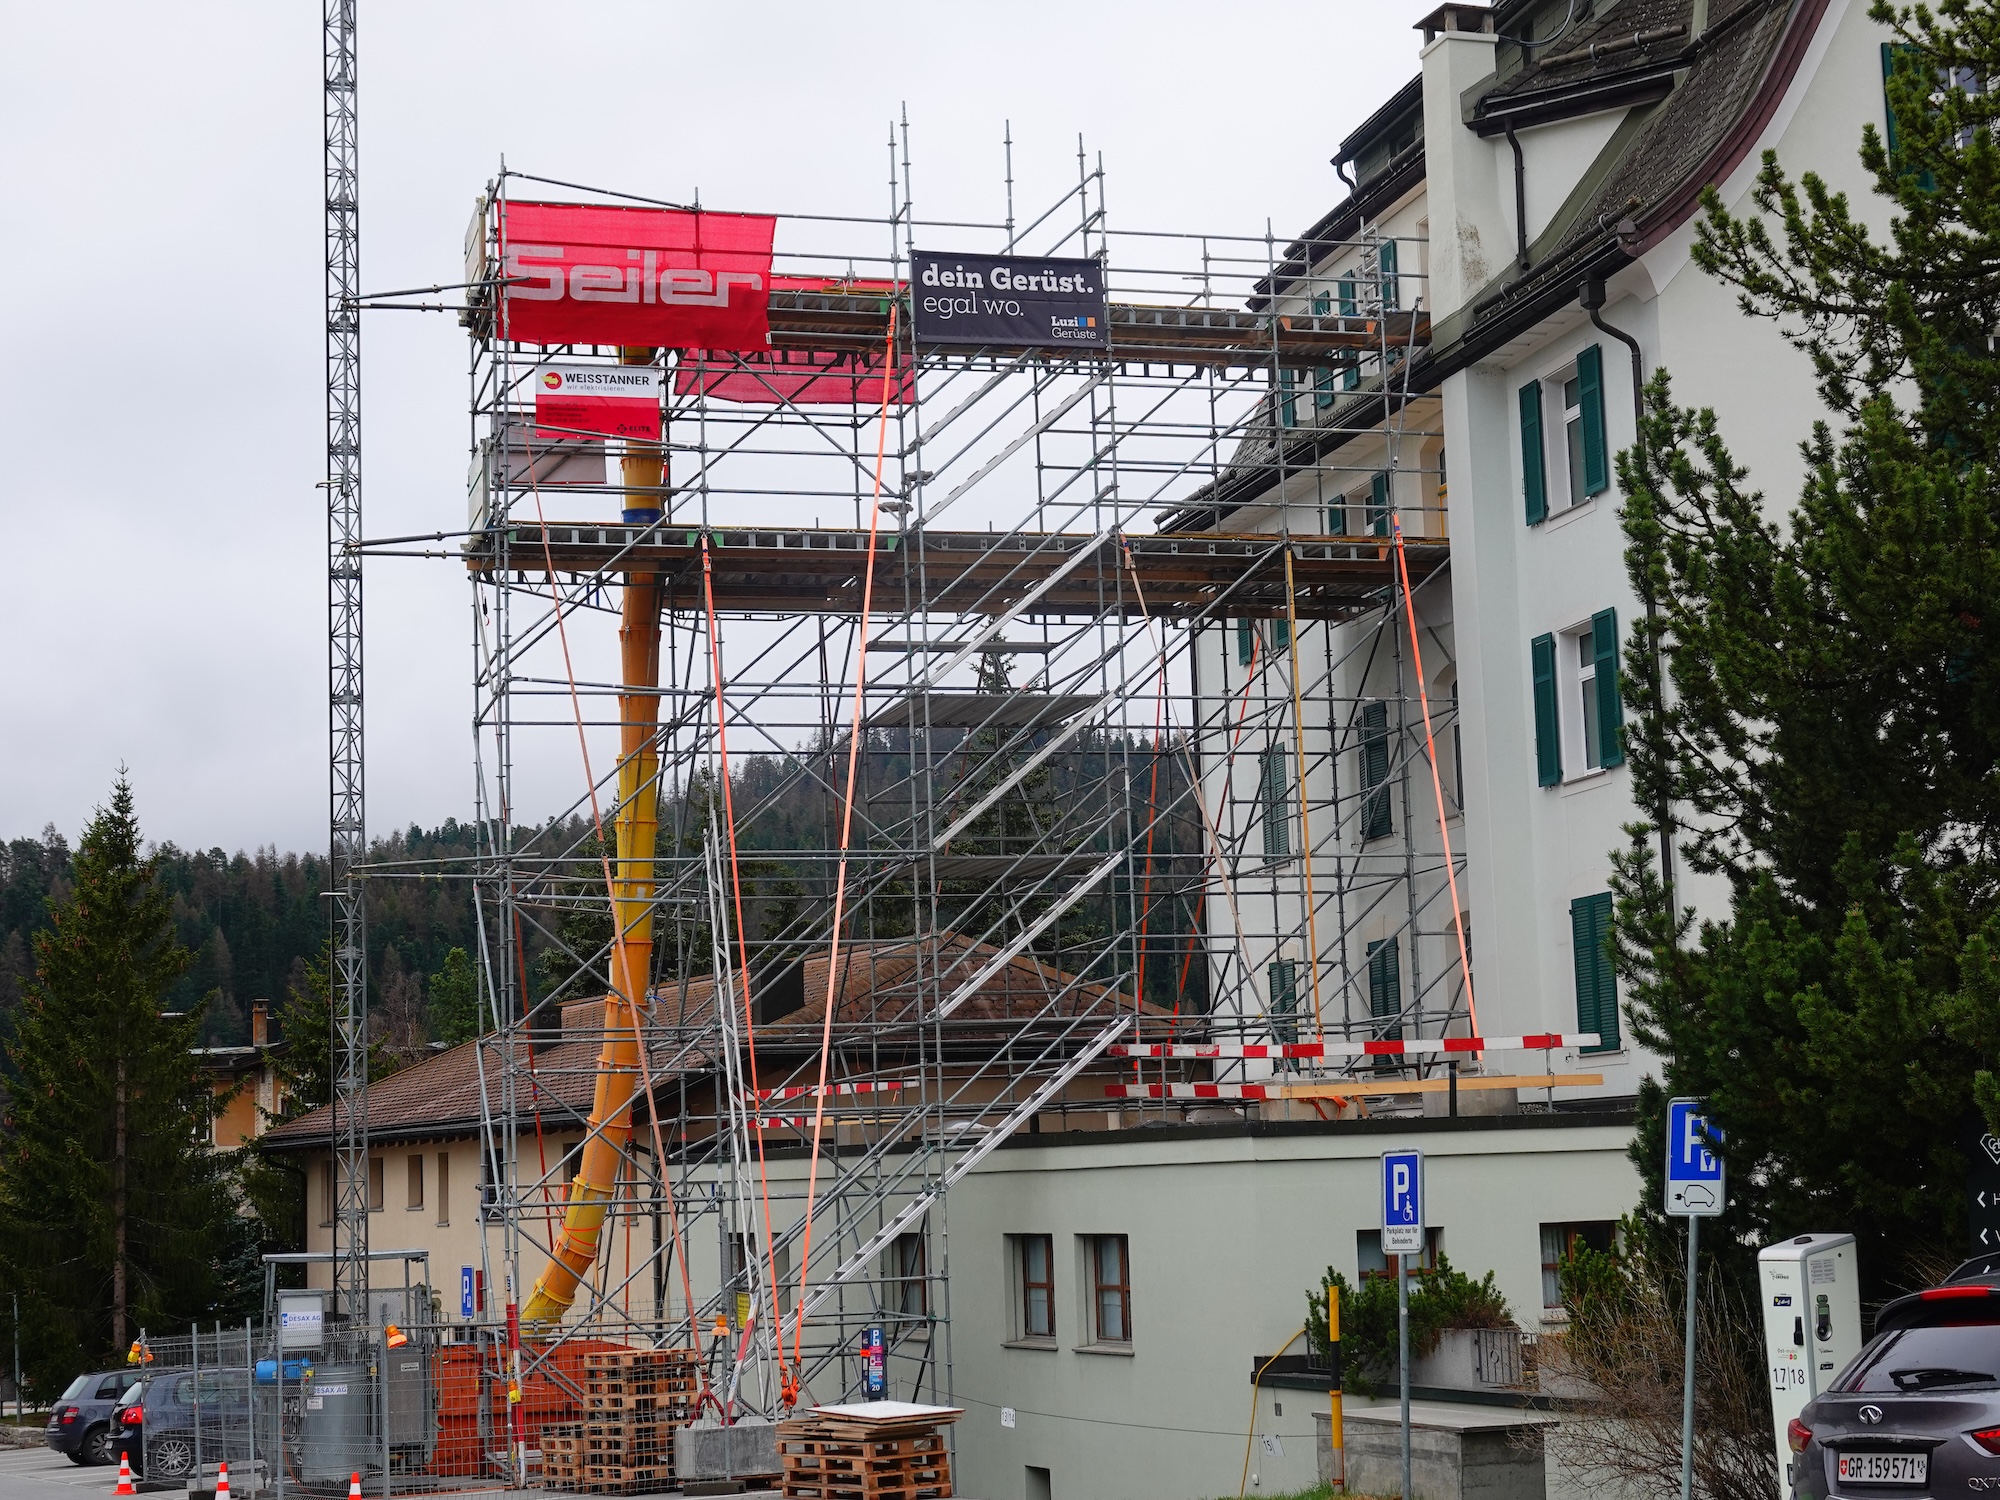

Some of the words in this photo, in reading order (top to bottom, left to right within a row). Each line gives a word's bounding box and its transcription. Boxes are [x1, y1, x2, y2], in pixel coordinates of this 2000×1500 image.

[506, 243, 763, 308] Seiler
[921, 263, 983, 289] dein
[990, 266, 1094, 294] Gerüst.
[923, 291, 979, 319] egal
[983, 300, 1024, 316] wo.
[1051, 316, 1079, 327] Luzi
[1052, 327, 1097, 339] Gerüste
[565, 373, 650, 386] WEISSTANNER
[1393, 1164, 1409, 1211] P
[1386, 1227, 1404, 1235] Parkplatz
[463, 1275, 469, 1303] P
